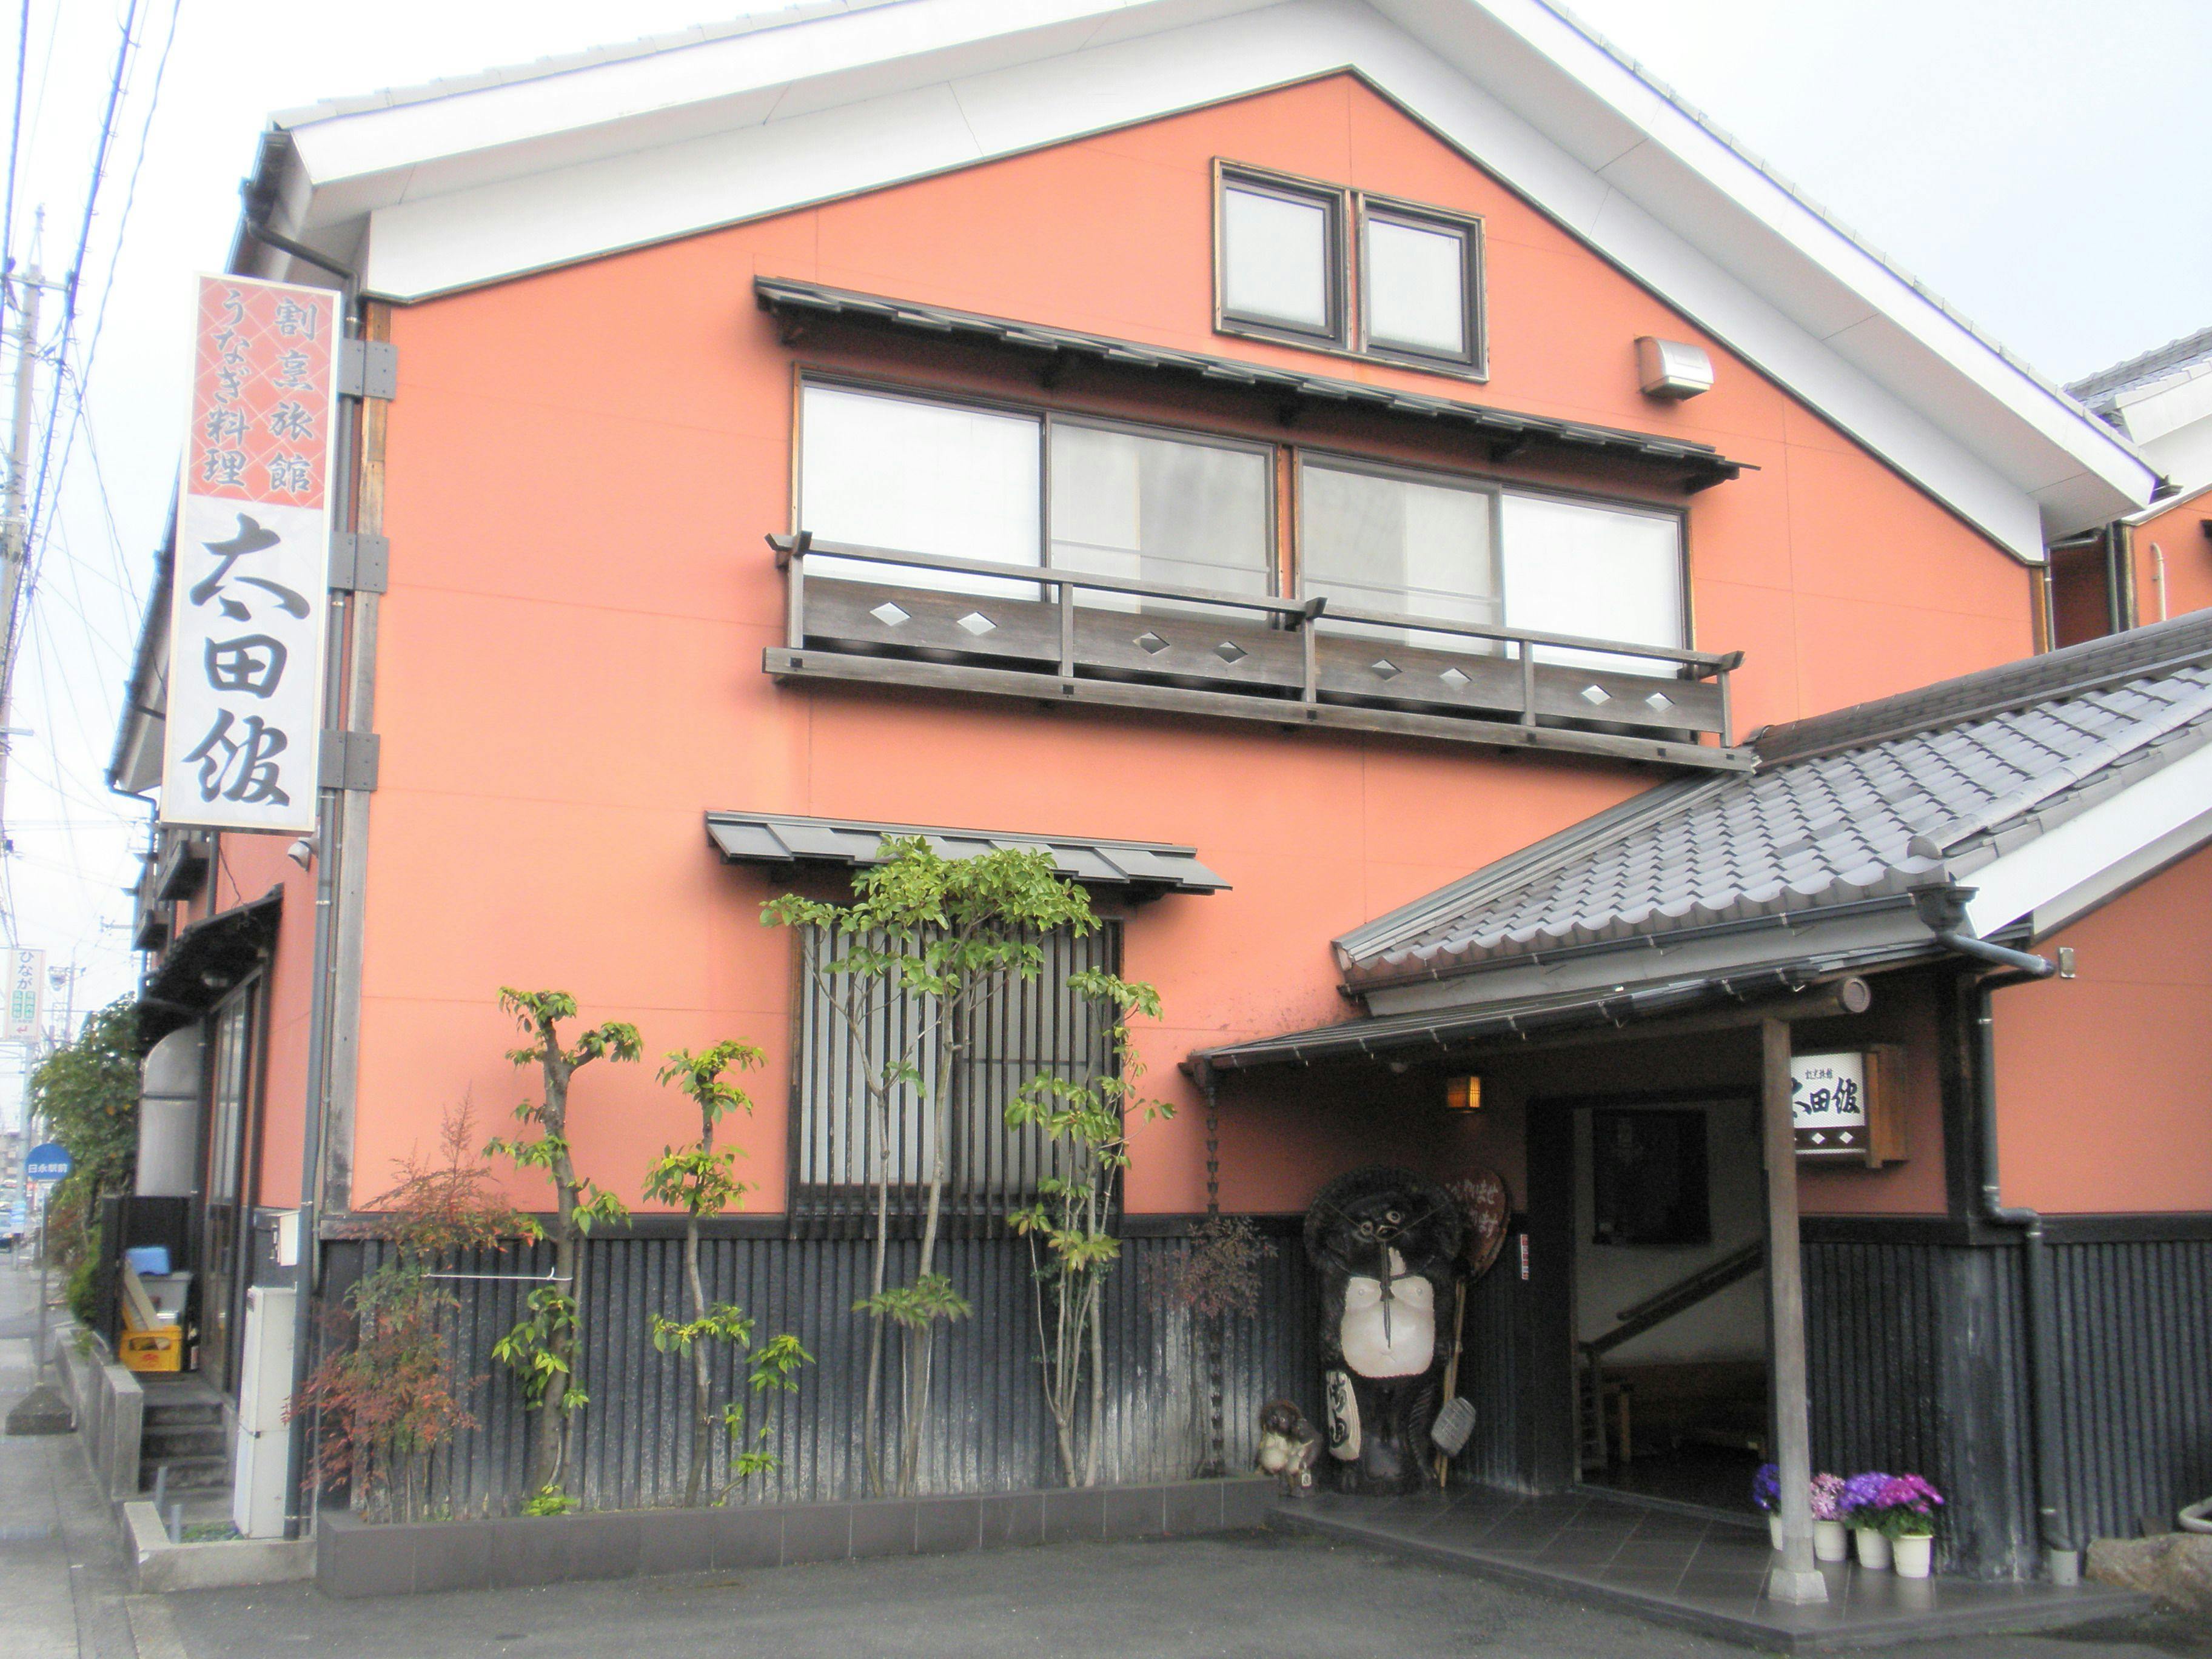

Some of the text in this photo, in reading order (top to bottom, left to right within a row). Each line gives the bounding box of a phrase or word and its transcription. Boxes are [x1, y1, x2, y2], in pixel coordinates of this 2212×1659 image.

[202, 289, 251, 487] うなぎ料理
[267, 297, 318, 494] 割烹旅館
